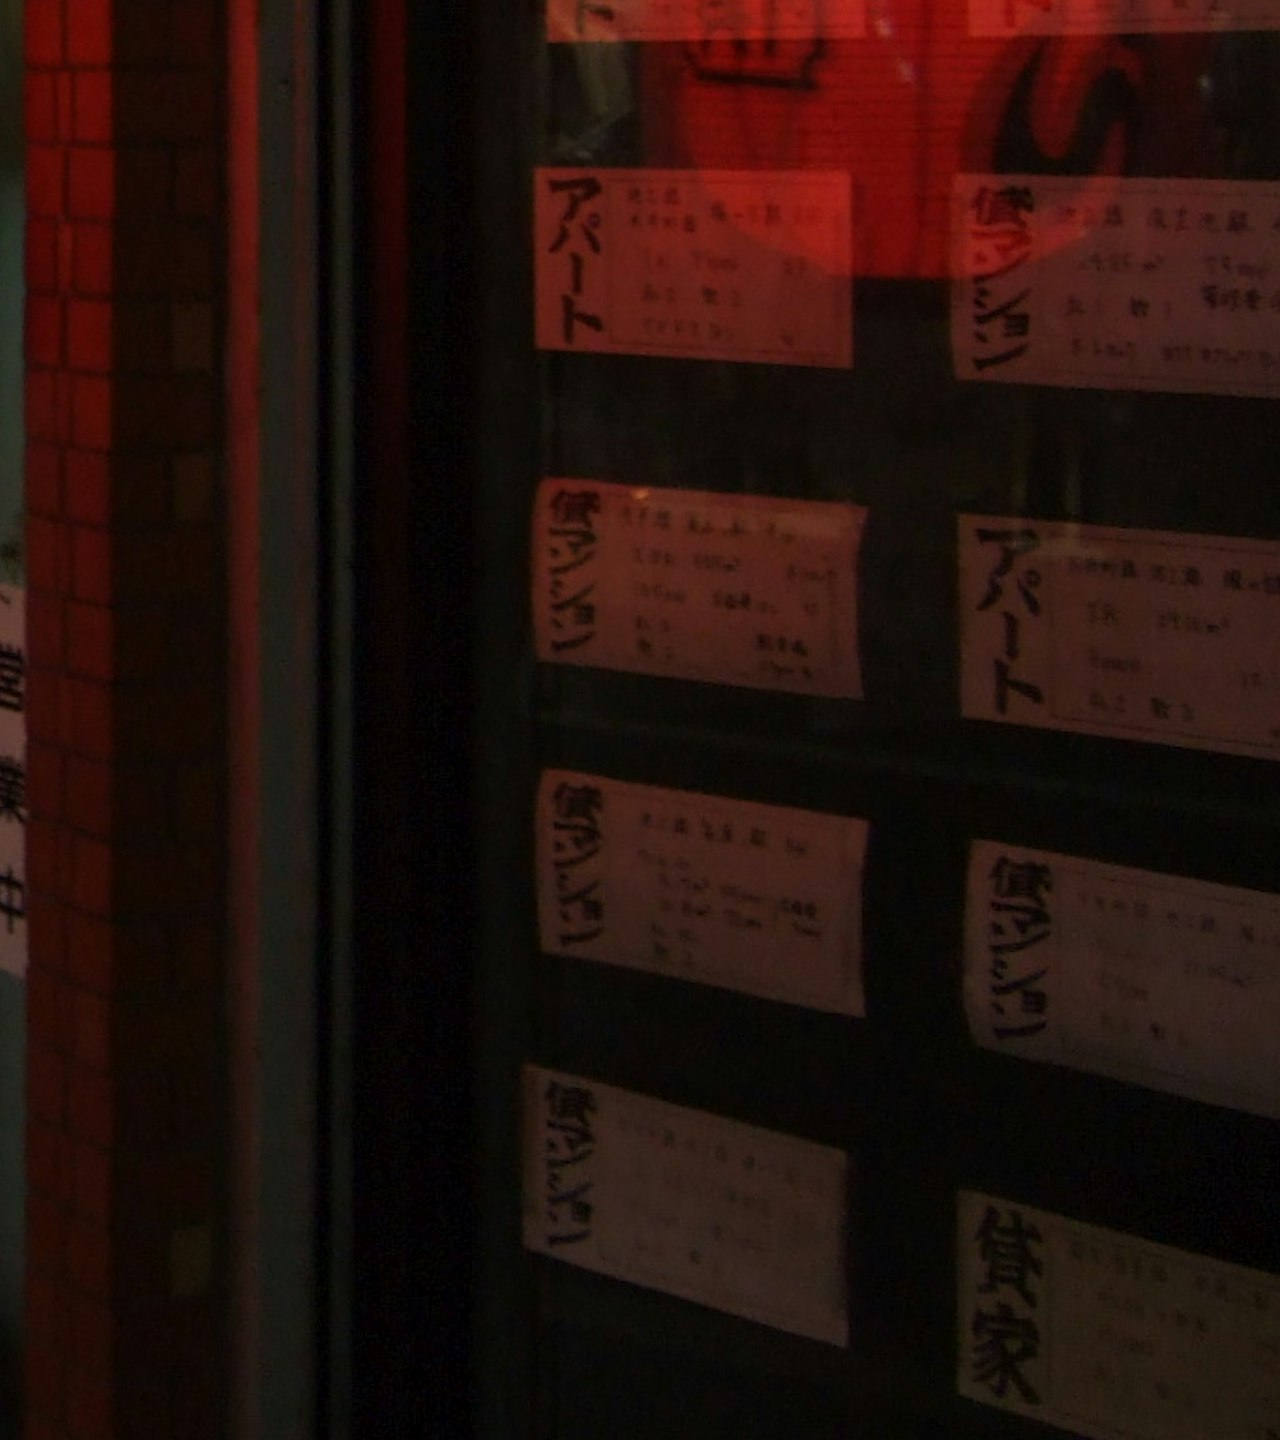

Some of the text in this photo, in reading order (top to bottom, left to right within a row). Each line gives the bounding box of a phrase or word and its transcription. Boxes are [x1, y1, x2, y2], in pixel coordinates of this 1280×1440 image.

[548, 177, 602, 345] アパート
[975, 528, 1044, 715] アパート
